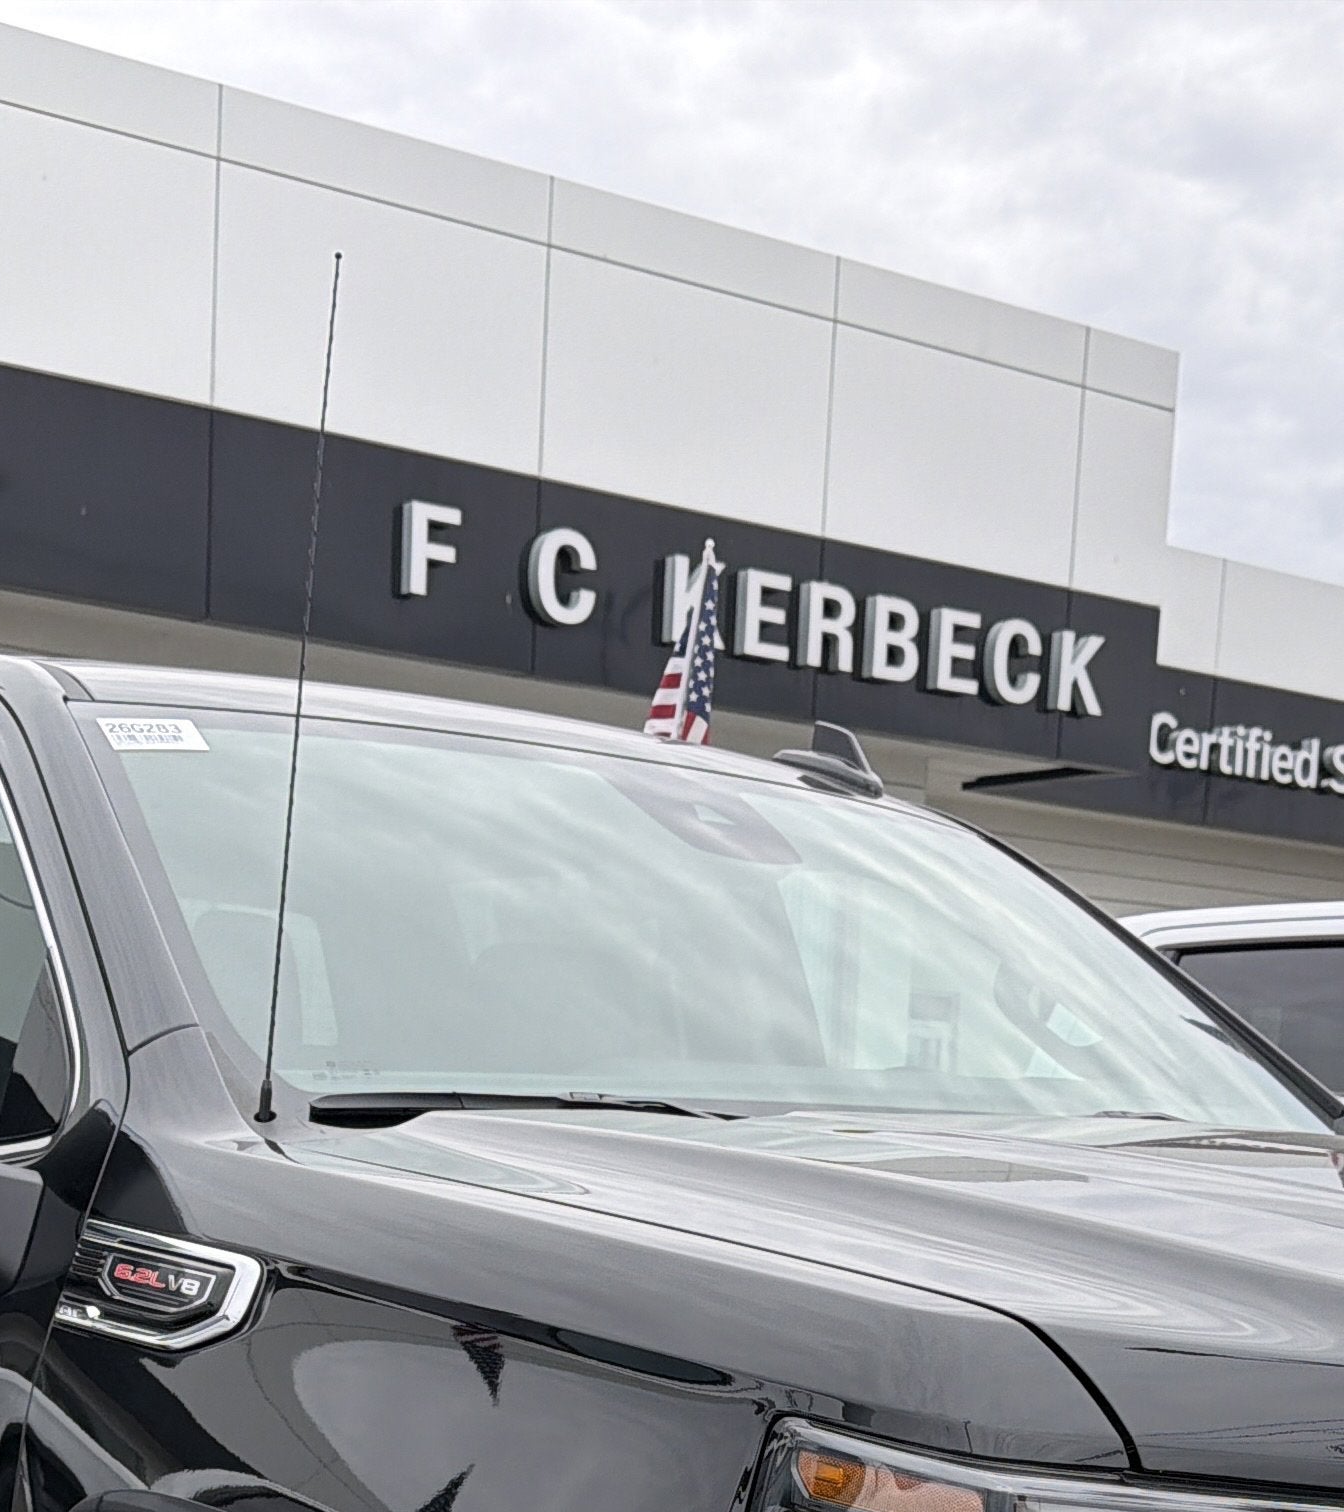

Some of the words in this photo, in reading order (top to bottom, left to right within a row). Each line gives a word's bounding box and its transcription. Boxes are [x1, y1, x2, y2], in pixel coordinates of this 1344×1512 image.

[400, 500, 461, 597] F
[528, 527, 597, 625] C
[1148, 711, 1321, 789] Certified
[167, 1274, 201, 1296] V8
